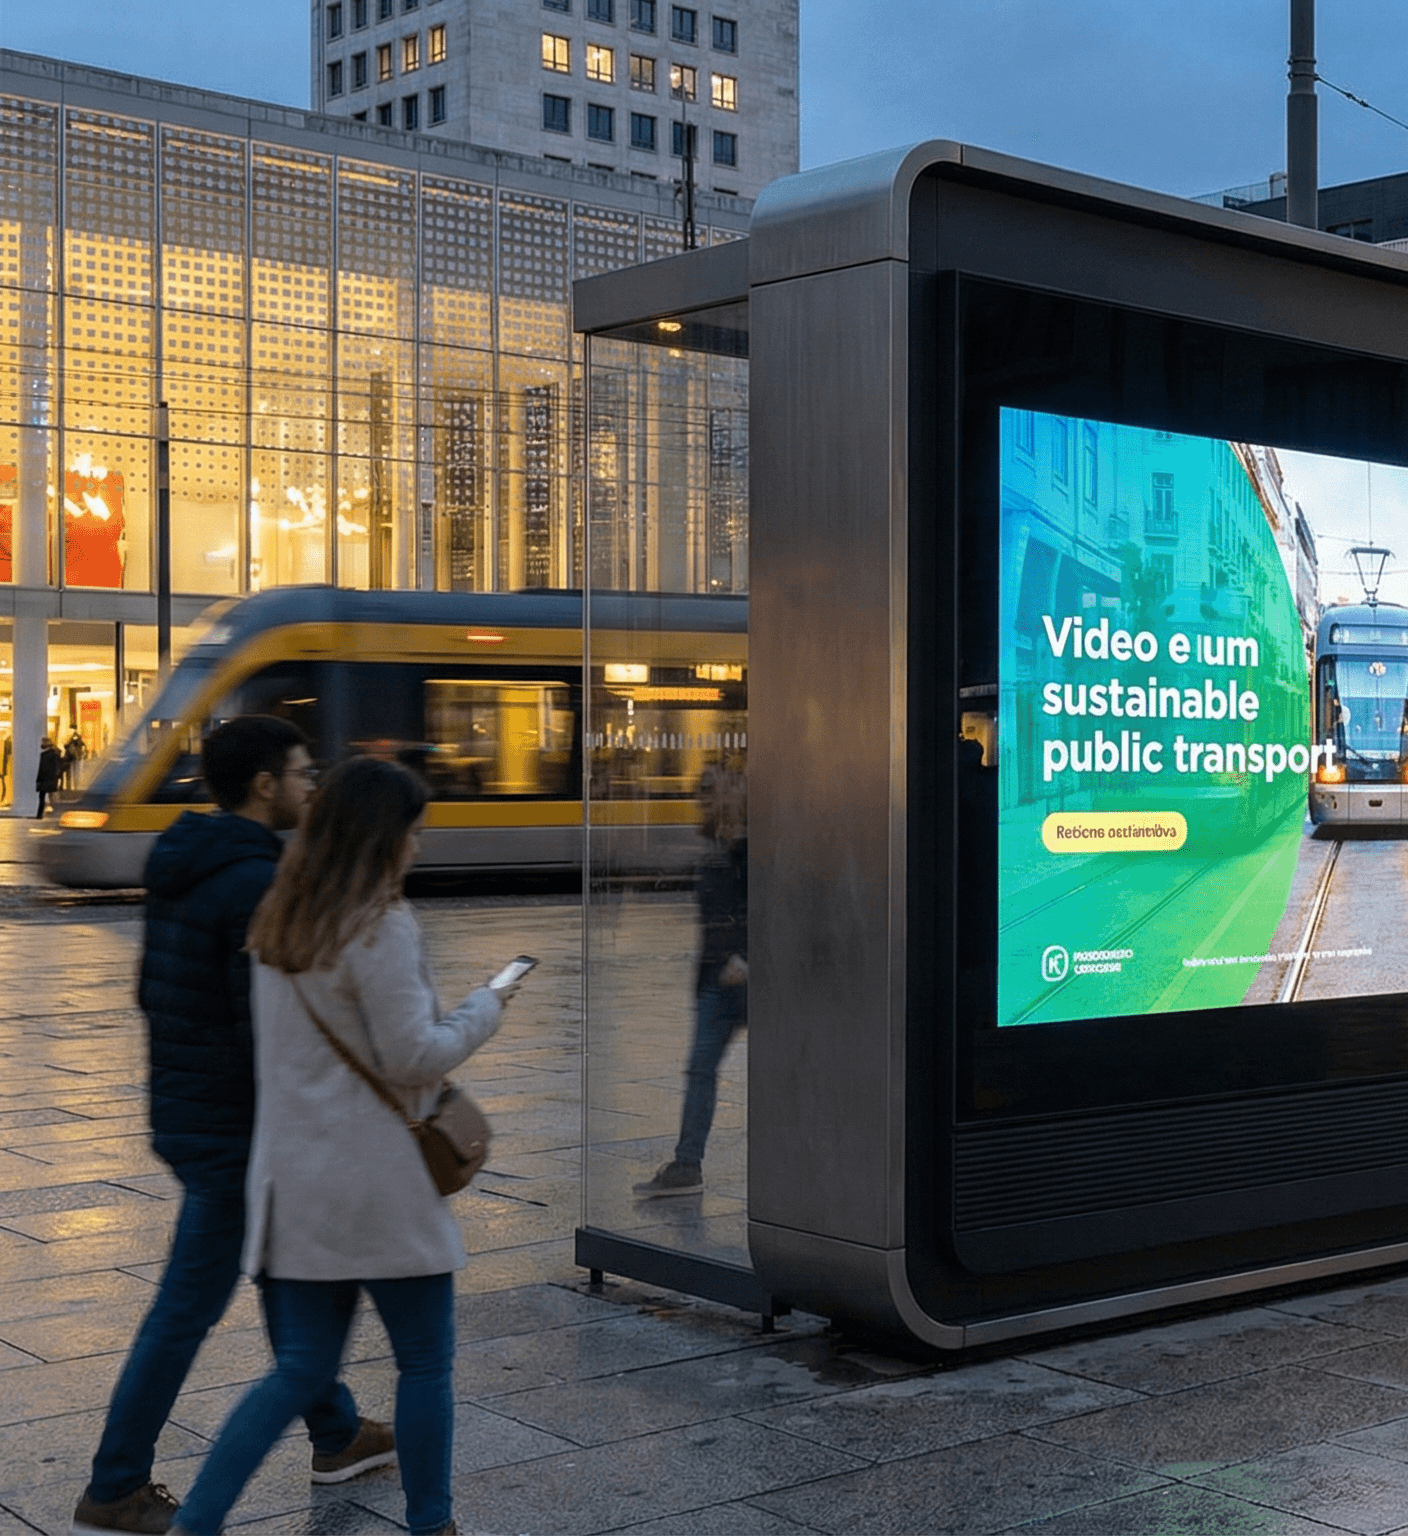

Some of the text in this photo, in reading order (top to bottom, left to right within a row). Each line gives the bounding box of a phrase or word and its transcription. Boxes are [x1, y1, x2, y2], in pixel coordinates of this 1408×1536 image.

[1041, 614, 1159, 662] Video
[1041, 676, 1260, 720] sustainable
[1042, 730, 1337, 783] public transport
